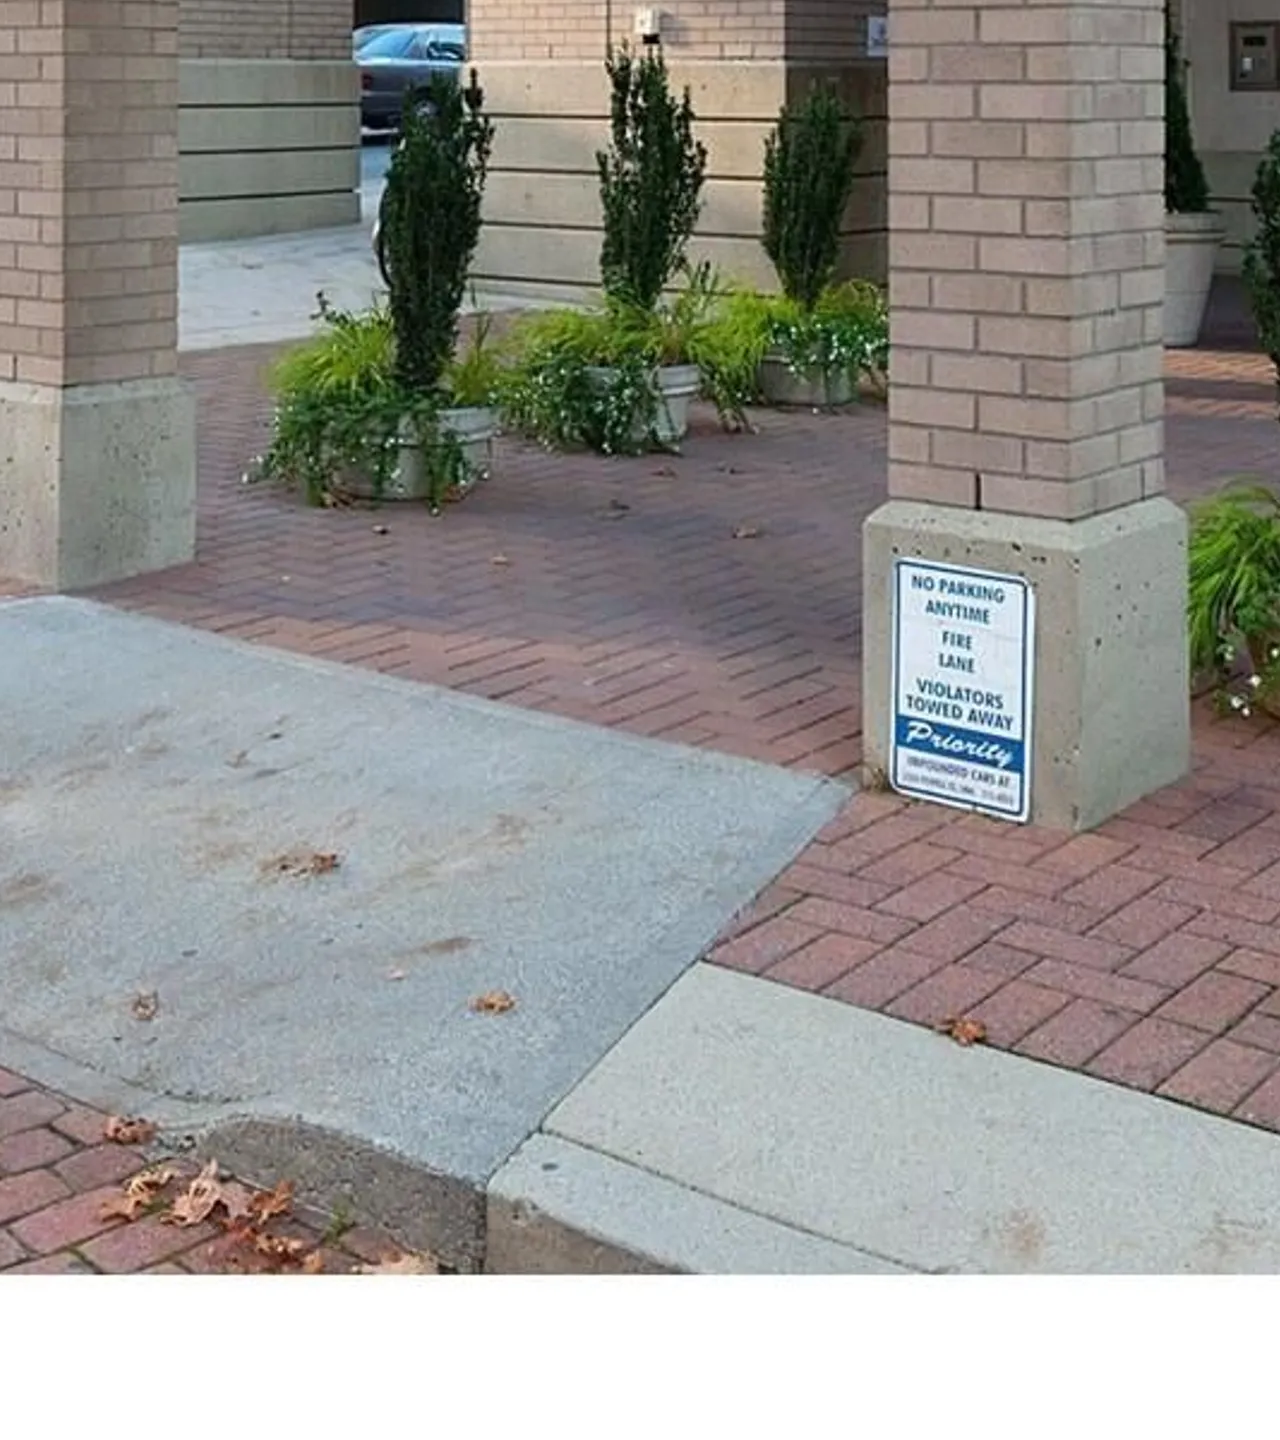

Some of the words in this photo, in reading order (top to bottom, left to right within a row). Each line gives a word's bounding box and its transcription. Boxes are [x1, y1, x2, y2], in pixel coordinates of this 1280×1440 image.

[912, 575, 935, 591] NO
[939, 579, 1006, 604] PARKING
[925, 599, 990, 625] ANYTIME
[942, 631, 973, 650] FIRE
[939, 653, 975, 673] LANE
[916, 678, 1004, 709] VIOLATORS
[906, 694, 963, 719] TOWED
[967, 708, 1013, 731] AWAY
[906, 720, 1013, 768] Priority
[971, 769, 996, 785] CARS
[999, 776, 1011, 789] AT
